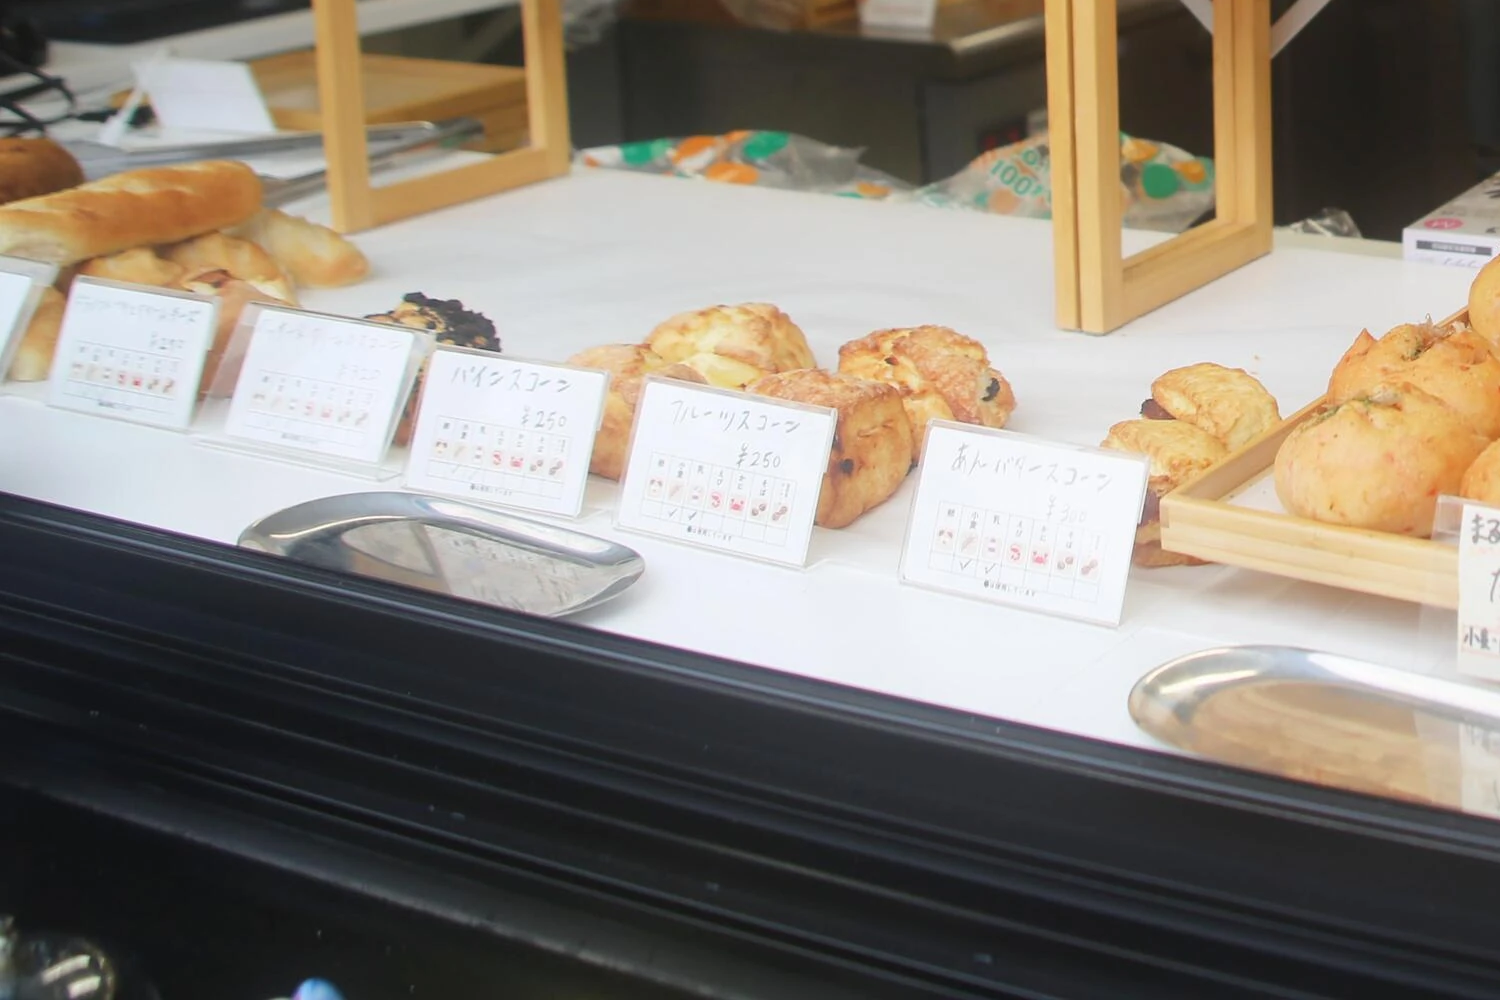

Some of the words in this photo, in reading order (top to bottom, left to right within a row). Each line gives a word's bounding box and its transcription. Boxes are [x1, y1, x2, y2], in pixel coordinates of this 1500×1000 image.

[671, 400, 801, 433] フルーツスコーン
[736, 443, 781, 469] ¥250
[951, 443, 1112, 492] あんバタースコーン
